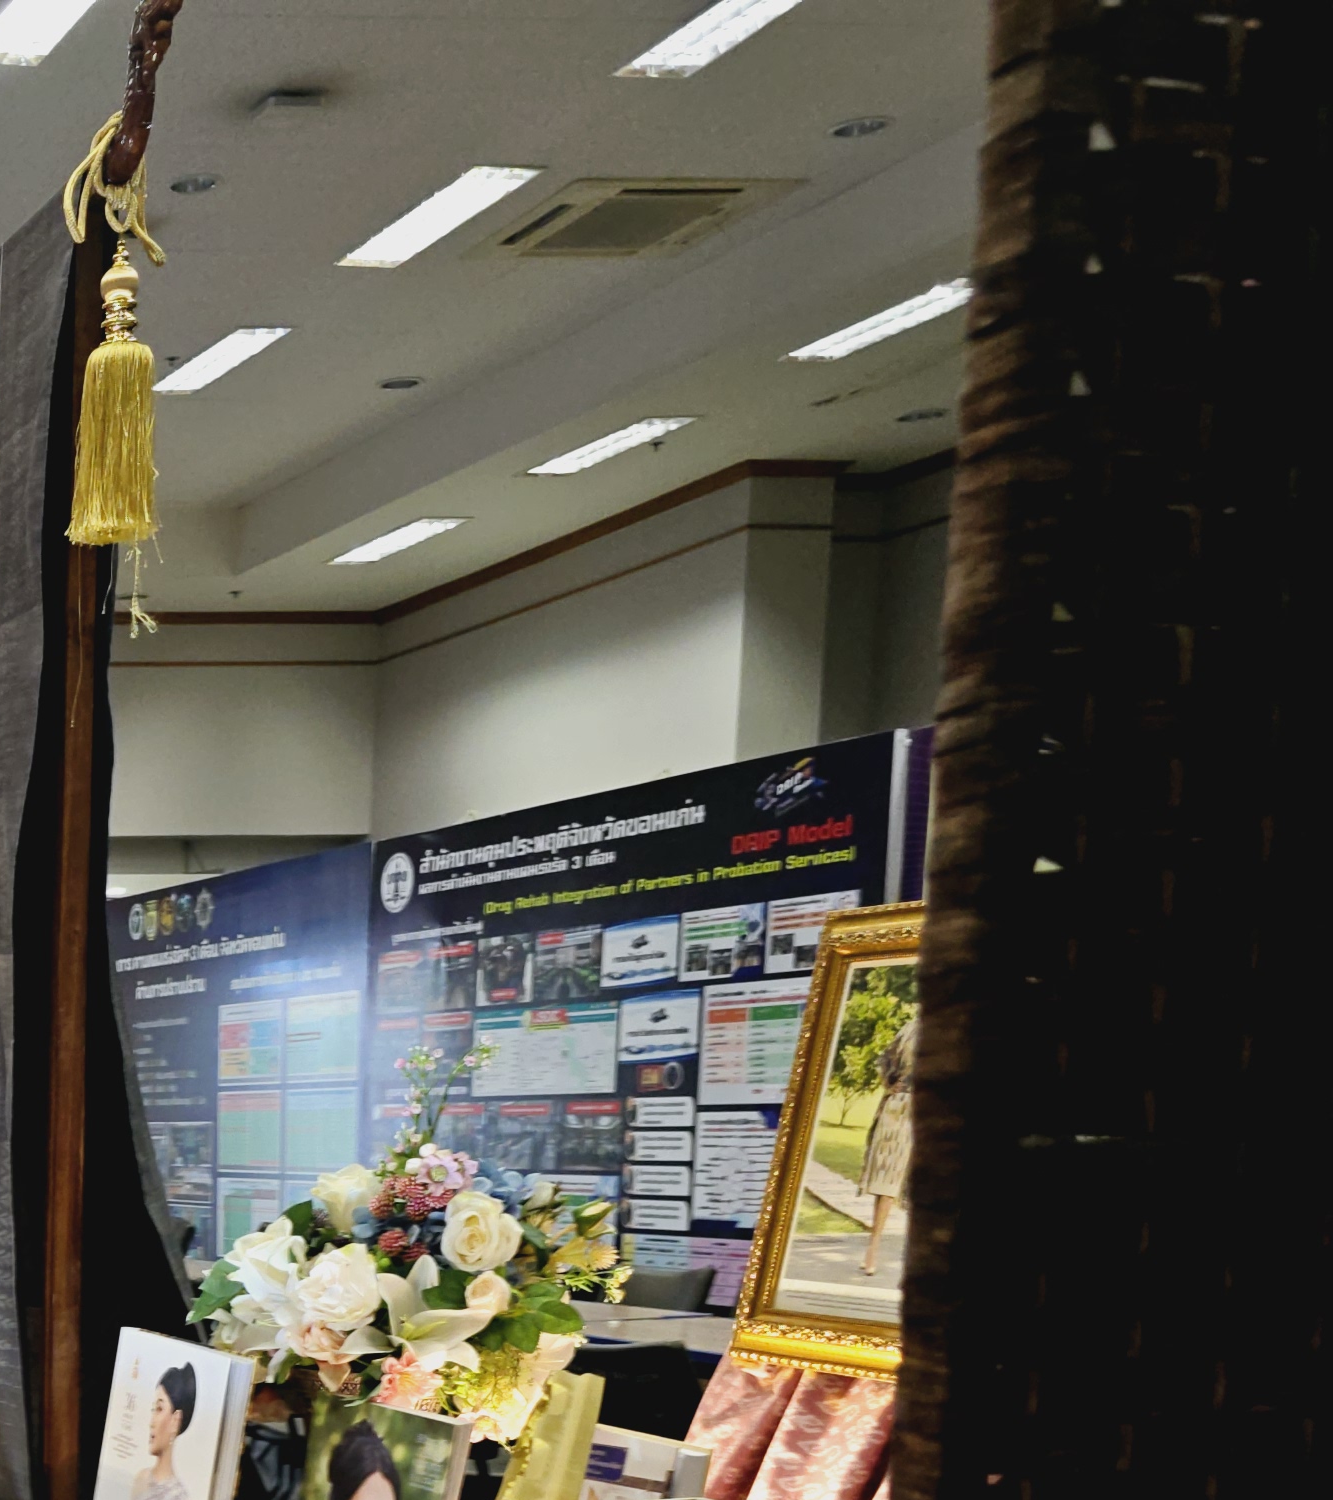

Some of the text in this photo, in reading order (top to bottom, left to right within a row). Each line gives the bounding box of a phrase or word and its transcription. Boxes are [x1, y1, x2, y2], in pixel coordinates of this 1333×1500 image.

[786, 814, 855, 846] Model
[552, 884, 618, 905] Integration
[620, 878, 635, 895] of
[636, 871, 695, 892] Partners
[696, 867, 711, 884] in
[712, 857, 783, 880] Probation
[785, 845, 857, 870] Services)
[571, 855, 582, 870] 3
